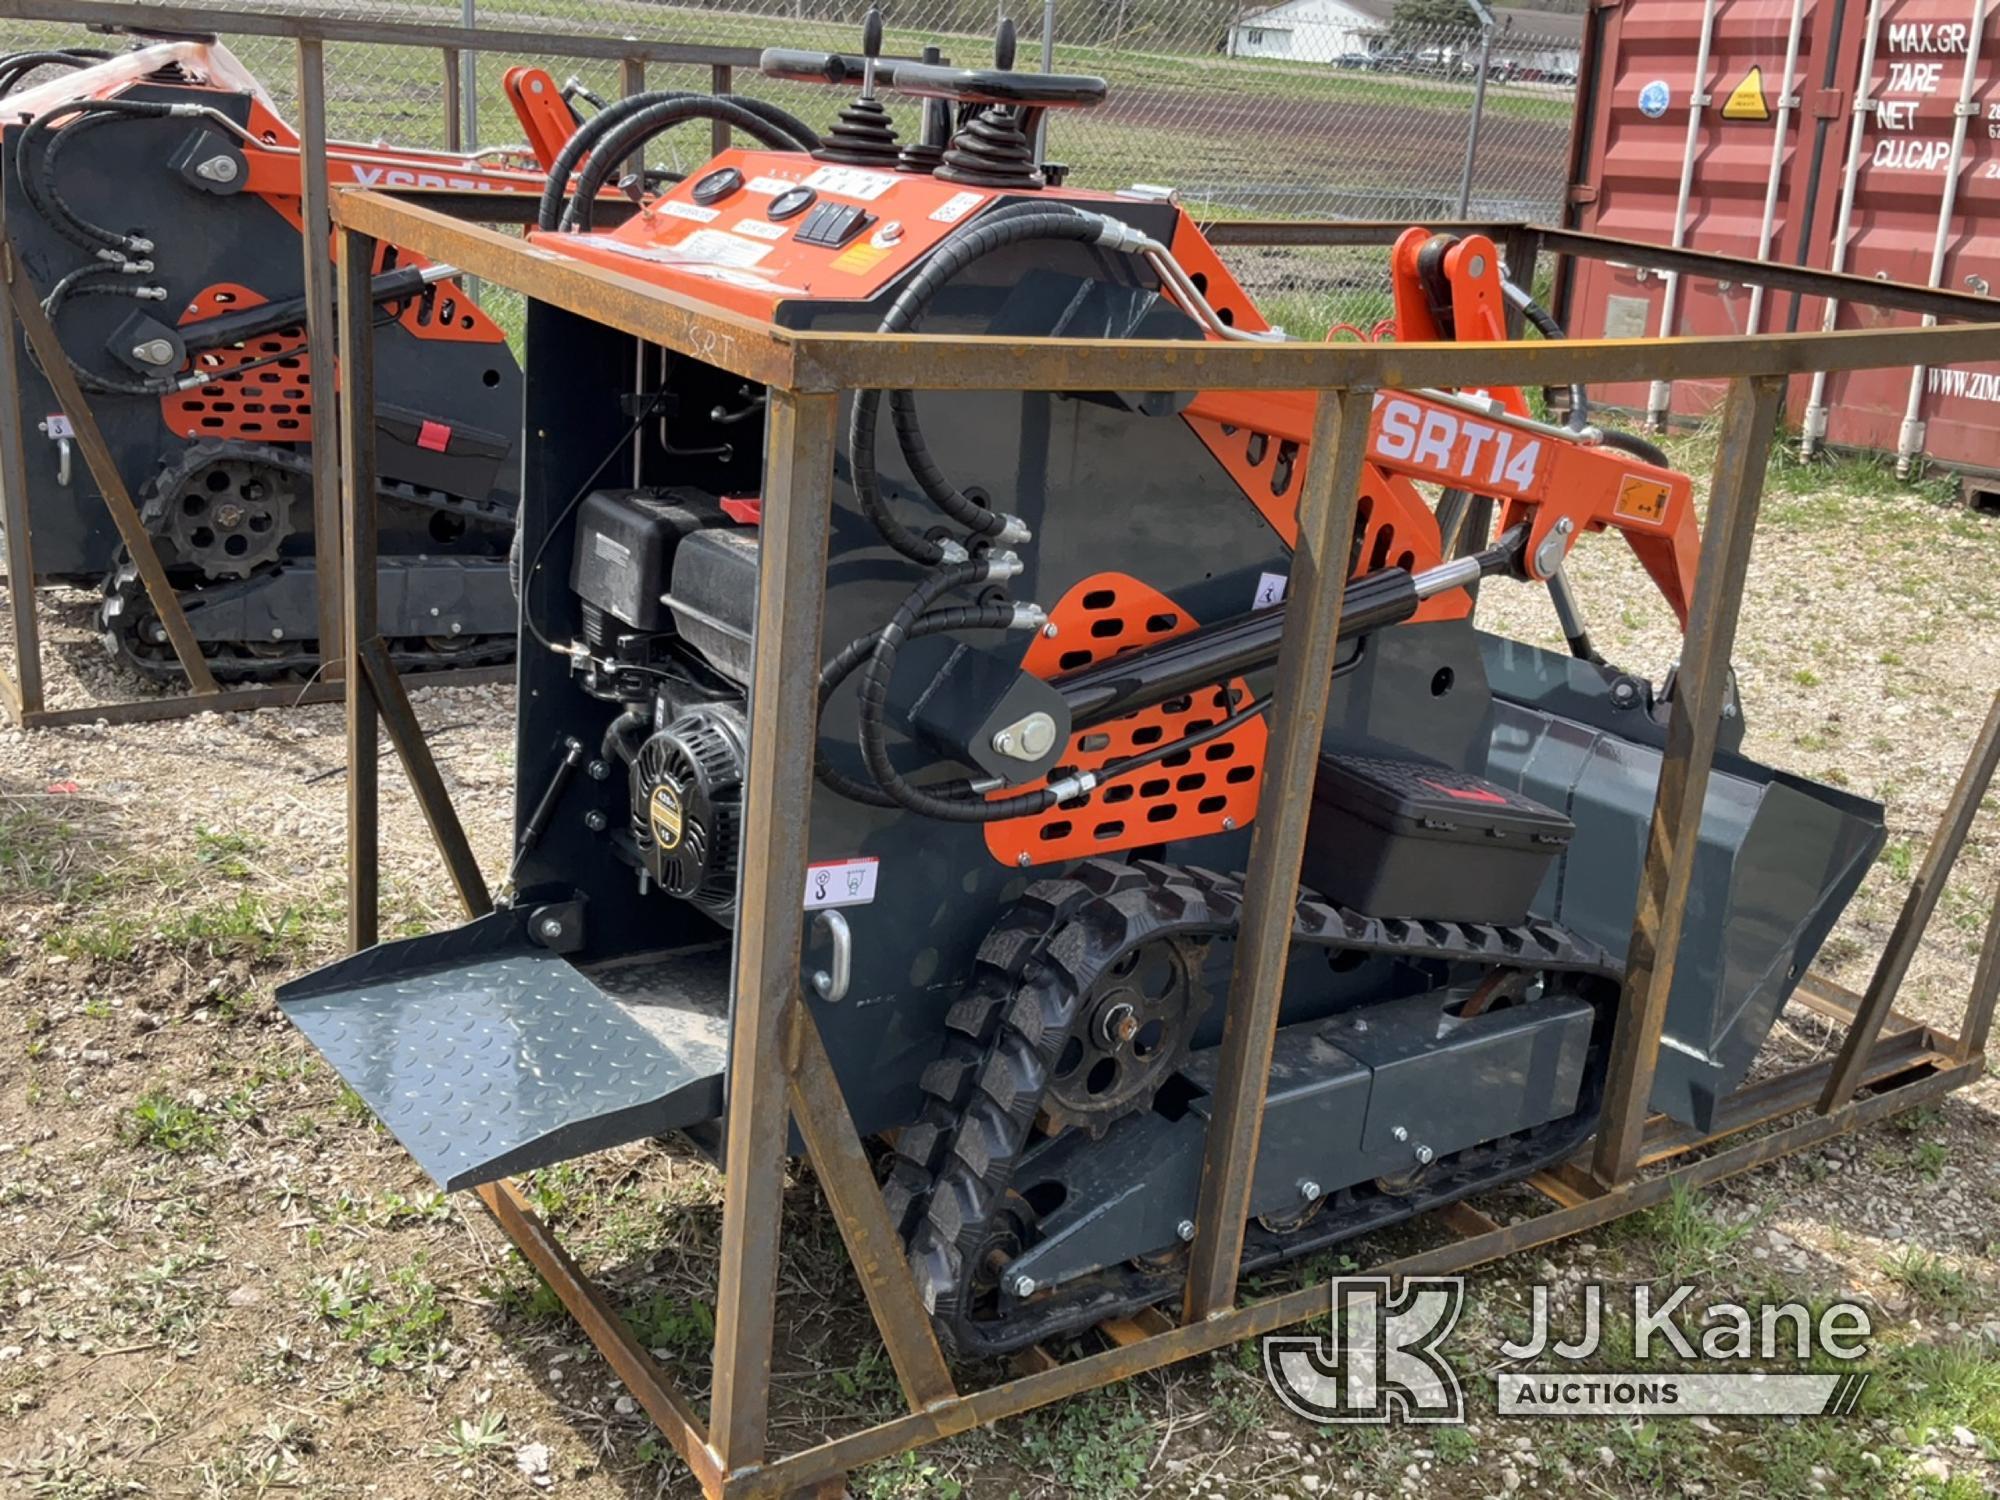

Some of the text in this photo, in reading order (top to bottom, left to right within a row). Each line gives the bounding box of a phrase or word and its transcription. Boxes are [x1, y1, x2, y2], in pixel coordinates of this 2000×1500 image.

[1888, 24, 1969, 53] MAX.GR.
[1887, 63, 1943, 92] TARE
[1876, 101, 1919, 130] NET
[1872, 140, 1953, 170] CU.CAP.
[1373, 394, 1540, 493] SRT14
